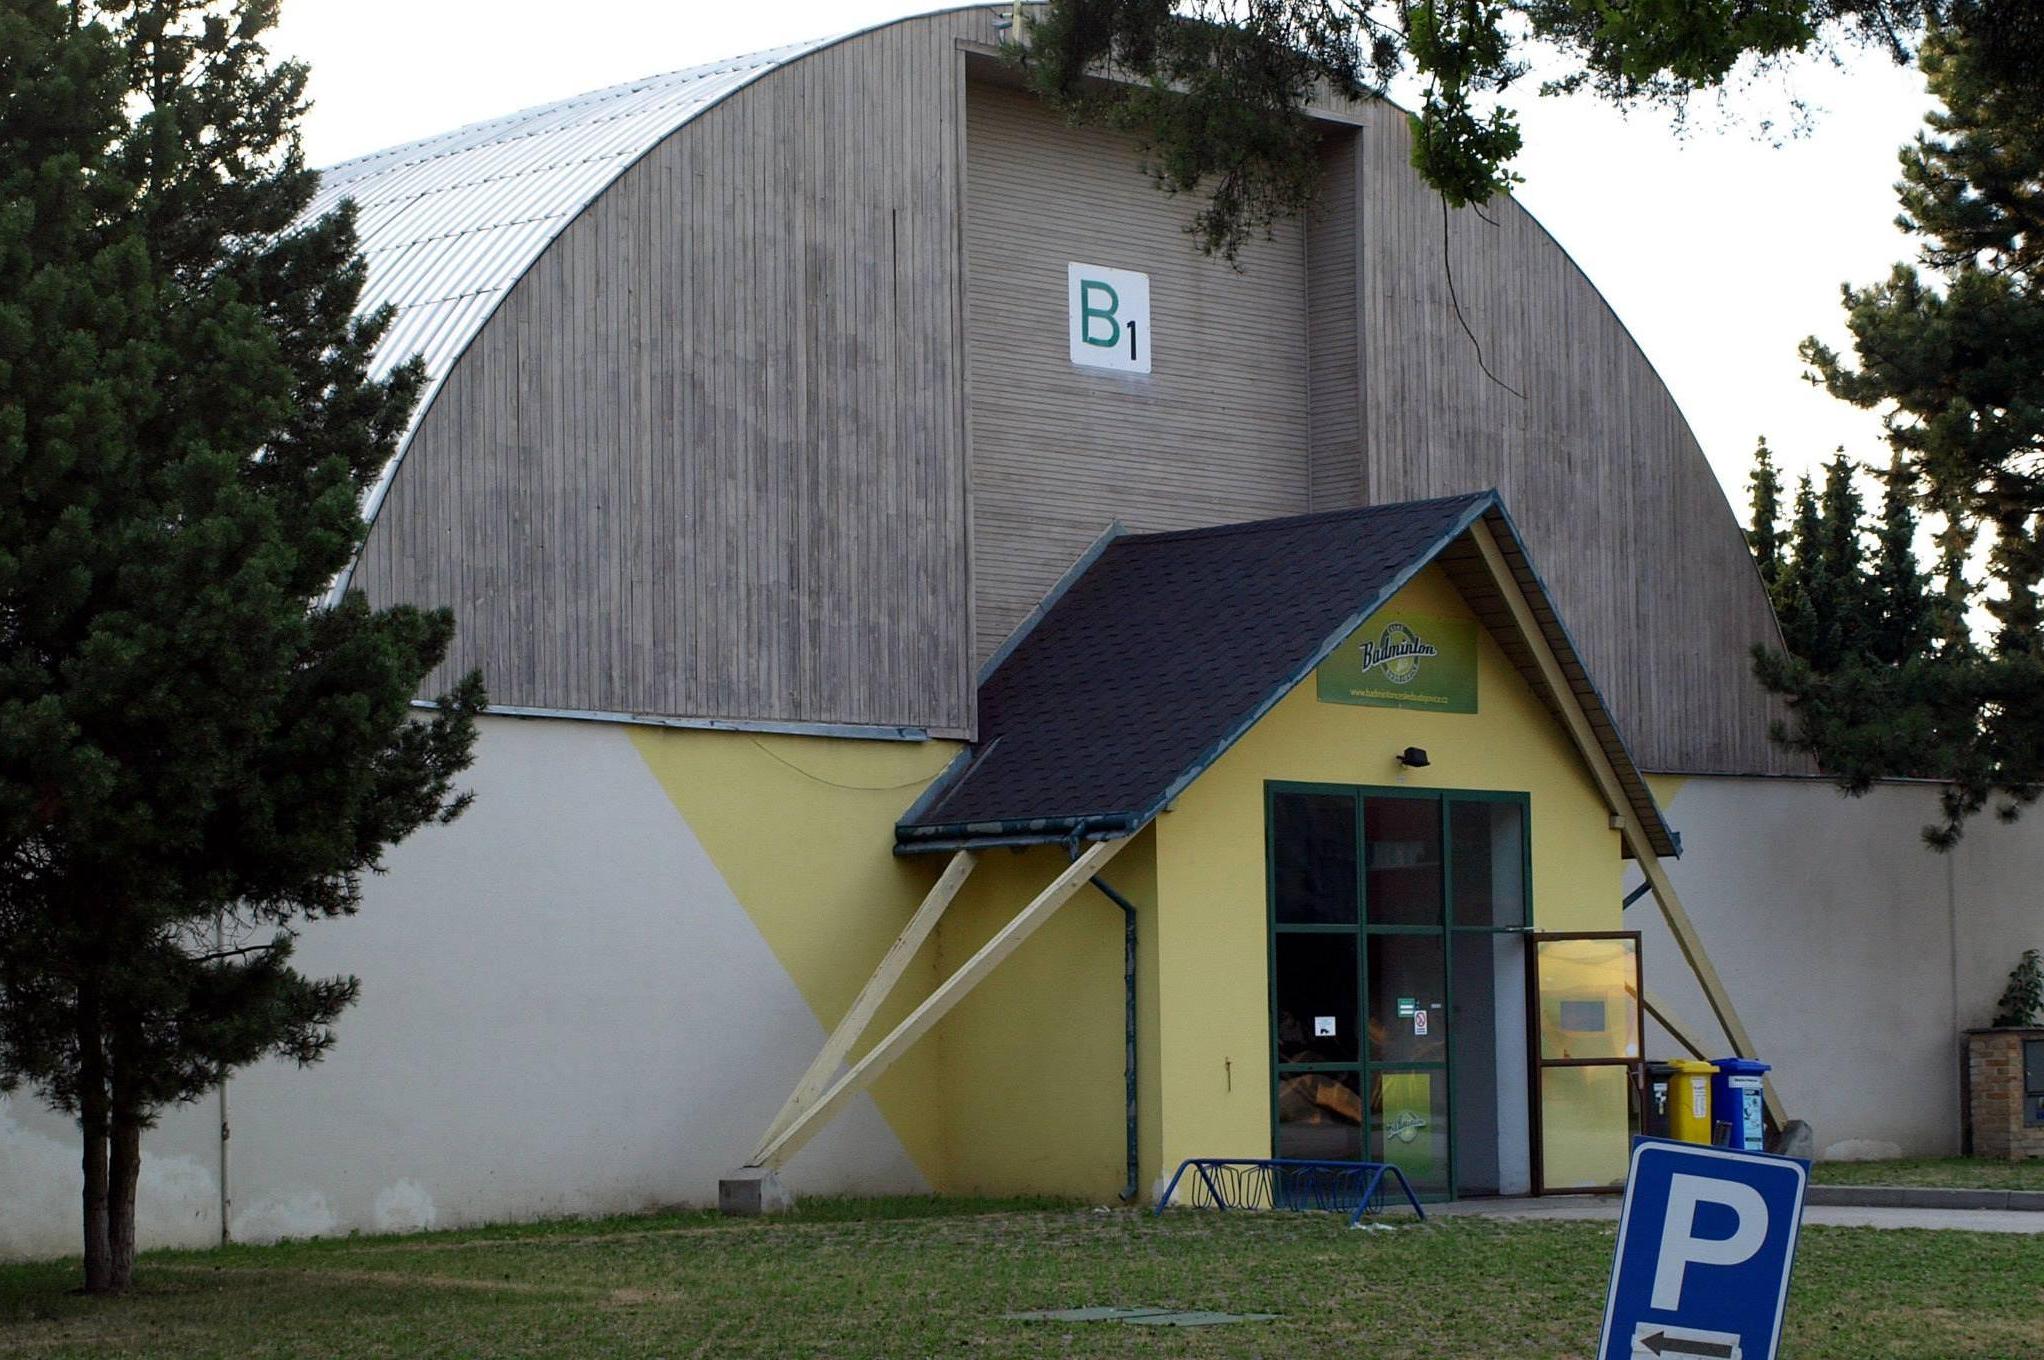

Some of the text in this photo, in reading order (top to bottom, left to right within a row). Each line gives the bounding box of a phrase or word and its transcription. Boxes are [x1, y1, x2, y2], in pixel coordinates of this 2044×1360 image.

[1081, 279, 1136, 360] B1
[1360, 636, 1436, 672] Badminton
[1650, 1173, 1768, 1311] P
